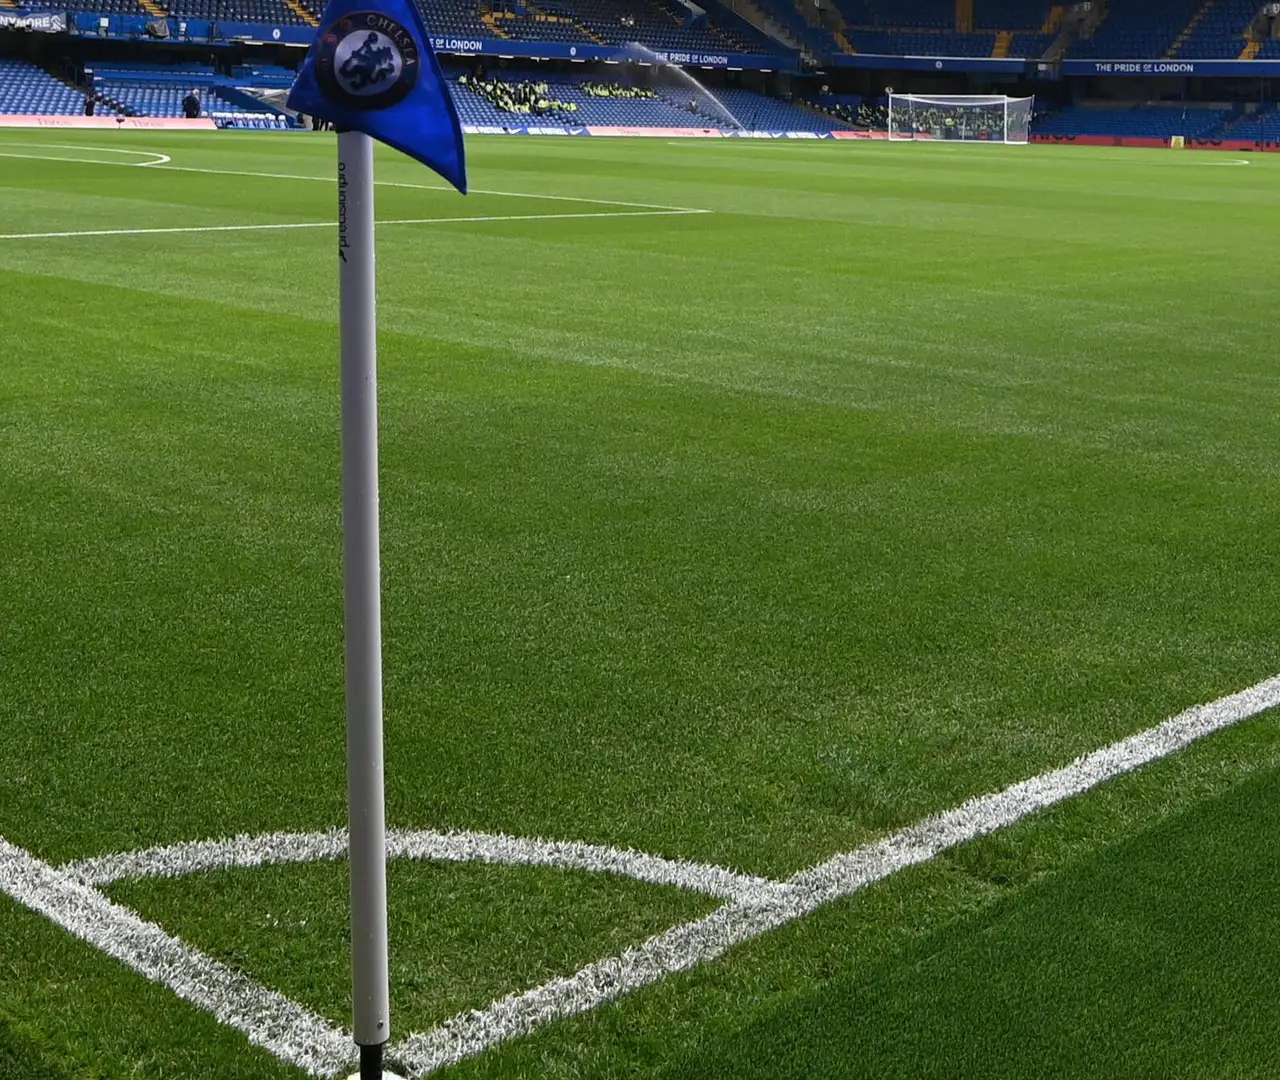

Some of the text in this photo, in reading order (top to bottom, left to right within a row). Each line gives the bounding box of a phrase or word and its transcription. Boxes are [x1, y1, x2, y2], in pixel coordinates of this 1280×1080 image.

[366, 14, 416, 66] CHELSEA
[435, 39, 445, 48] OF
[445, 40, 483, 50] LONDON
[654, 52, 669, 61] THE
[669, 53, 691, 63] PRIDE
[699, 55, 728, 65] LONDON
[1095, 63, 1194, 73] THE PRIDE OF LONDON
